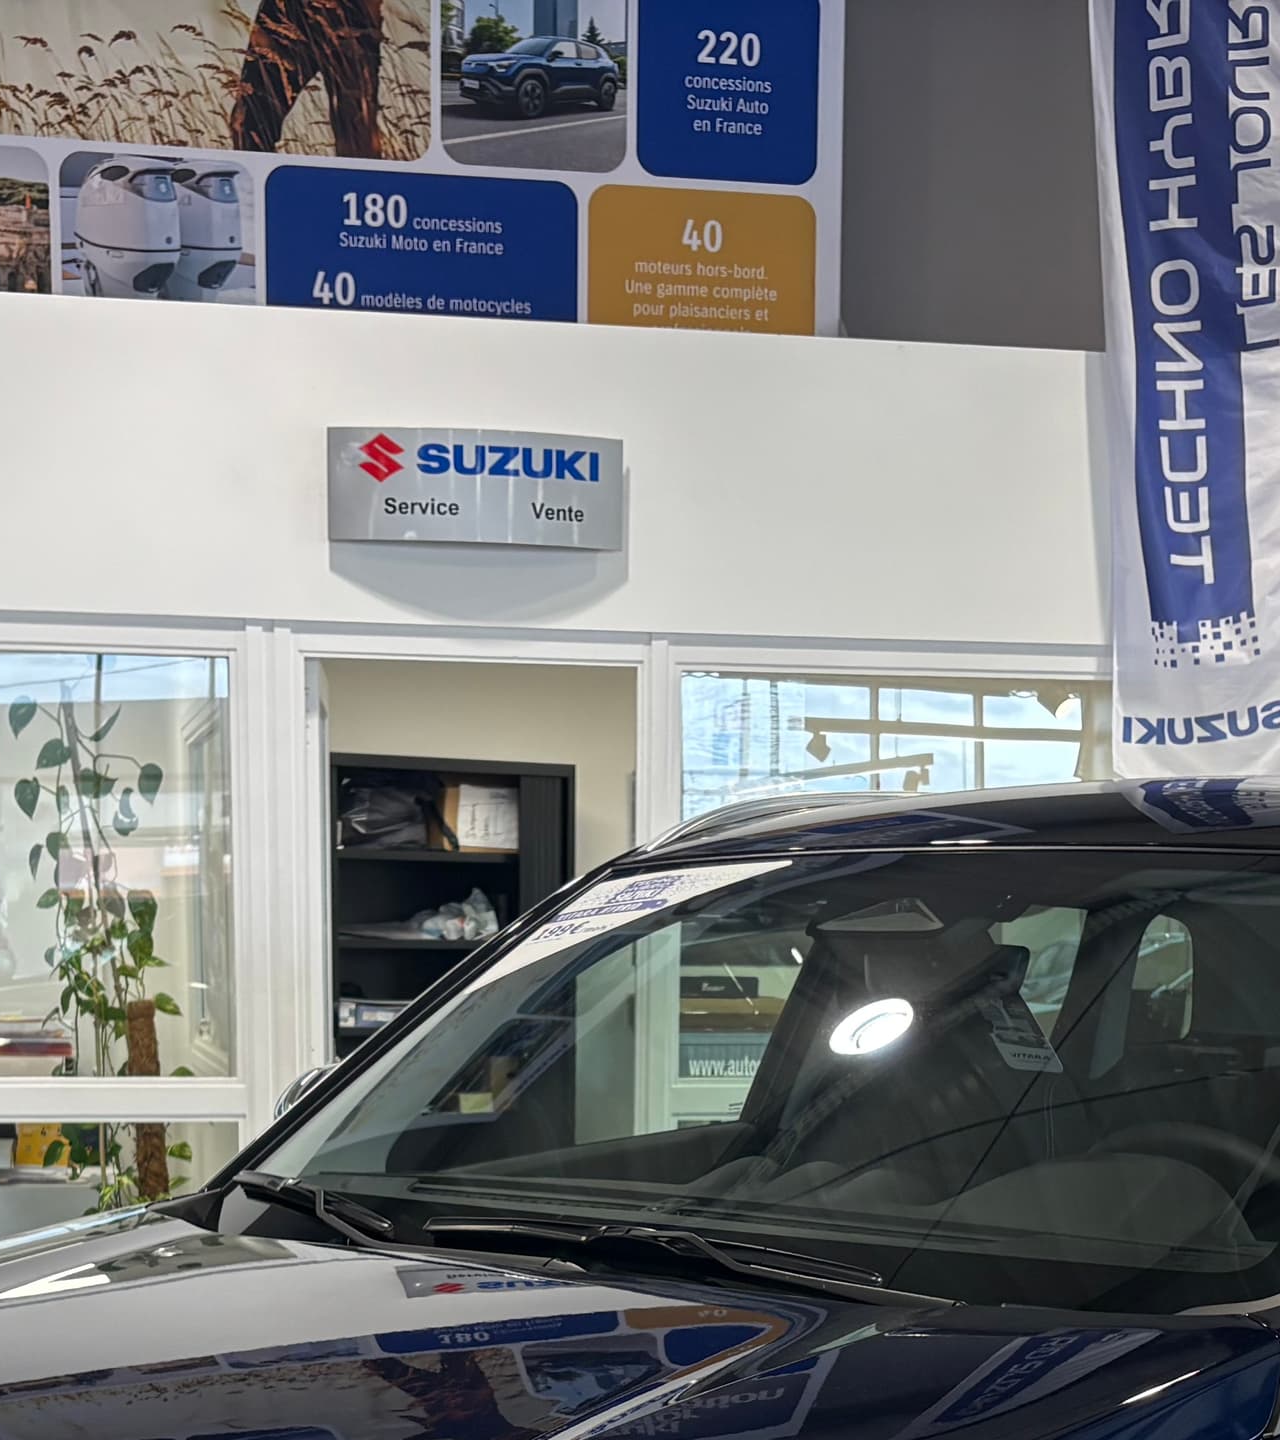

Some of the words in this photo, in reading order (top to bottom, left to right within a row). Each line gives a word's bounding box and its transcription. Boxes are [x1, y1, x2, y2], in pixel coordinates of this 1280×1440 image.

[697, 30, 761, 67] 220
[684, 76, 772, 93] concessions
[687, 94, 733, 112] Suzuki
[736, 98, 769, 115] Auto
[693, 119, 711, 132] en
[715, 118, 763, 135] France
[342, 192, 408, 229] 180
[412, 216, 503, 234] concessions
[339, 231, 387, 249] Suzuki
[391, 235, 428, 251] Moto
[433, 239, 451, 252] en
[455, 238, 504, 255] France
[682, 219, 723, 253] 40
[635, 260, 692, 276] moteurs
[696, 262, 768, 280] hors-bord.
[312, 271, 356, 305] 40
[361, 292, 422, 309] modèles
[427, 295, 445, 310] de
[449, 298, 532, 315] motocycles
[625, 279, 652, 295] Une
[657, 282, 709, 299] gamme
[713, 285, 777, 302] complète
[633, 302, 665, 318] pour
[670, 302, 751, 321] plaisanciers
[755, 308, 769, 321] et
[417, 443, 600, 482] SUZUKI
[384, 497, 460, 516] Service
[531, 502, 585, 523] Vente
[532, 920, 591, 941] 199€
